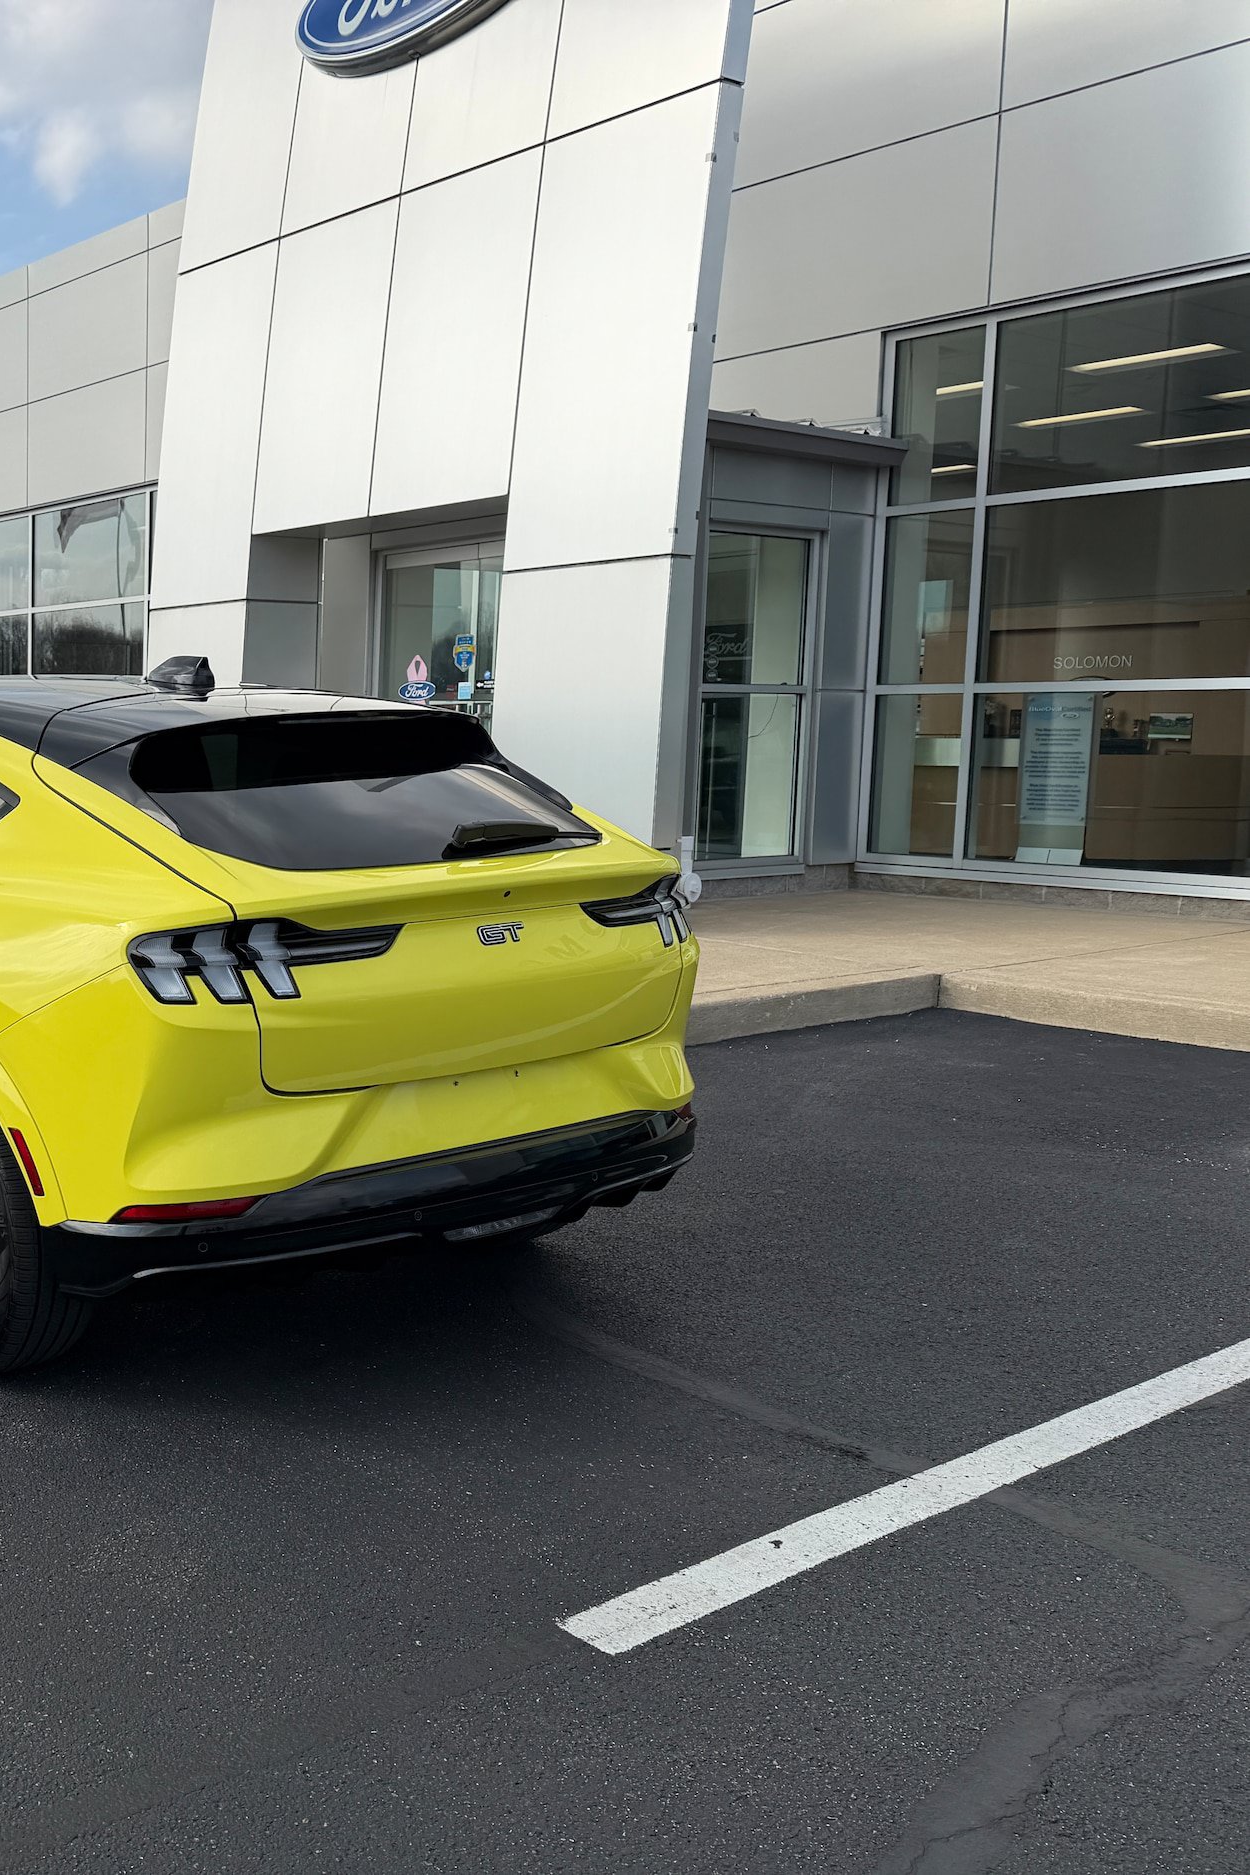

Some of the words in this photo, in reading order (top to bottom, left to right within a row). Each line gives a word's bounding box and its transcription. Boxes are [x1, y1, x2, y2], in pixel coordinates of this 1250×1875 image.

[1053, 655, 1132, 669] SOLOMON
[405, 683, 429, 698] Ford
[477, 921, 524, 946] GT
